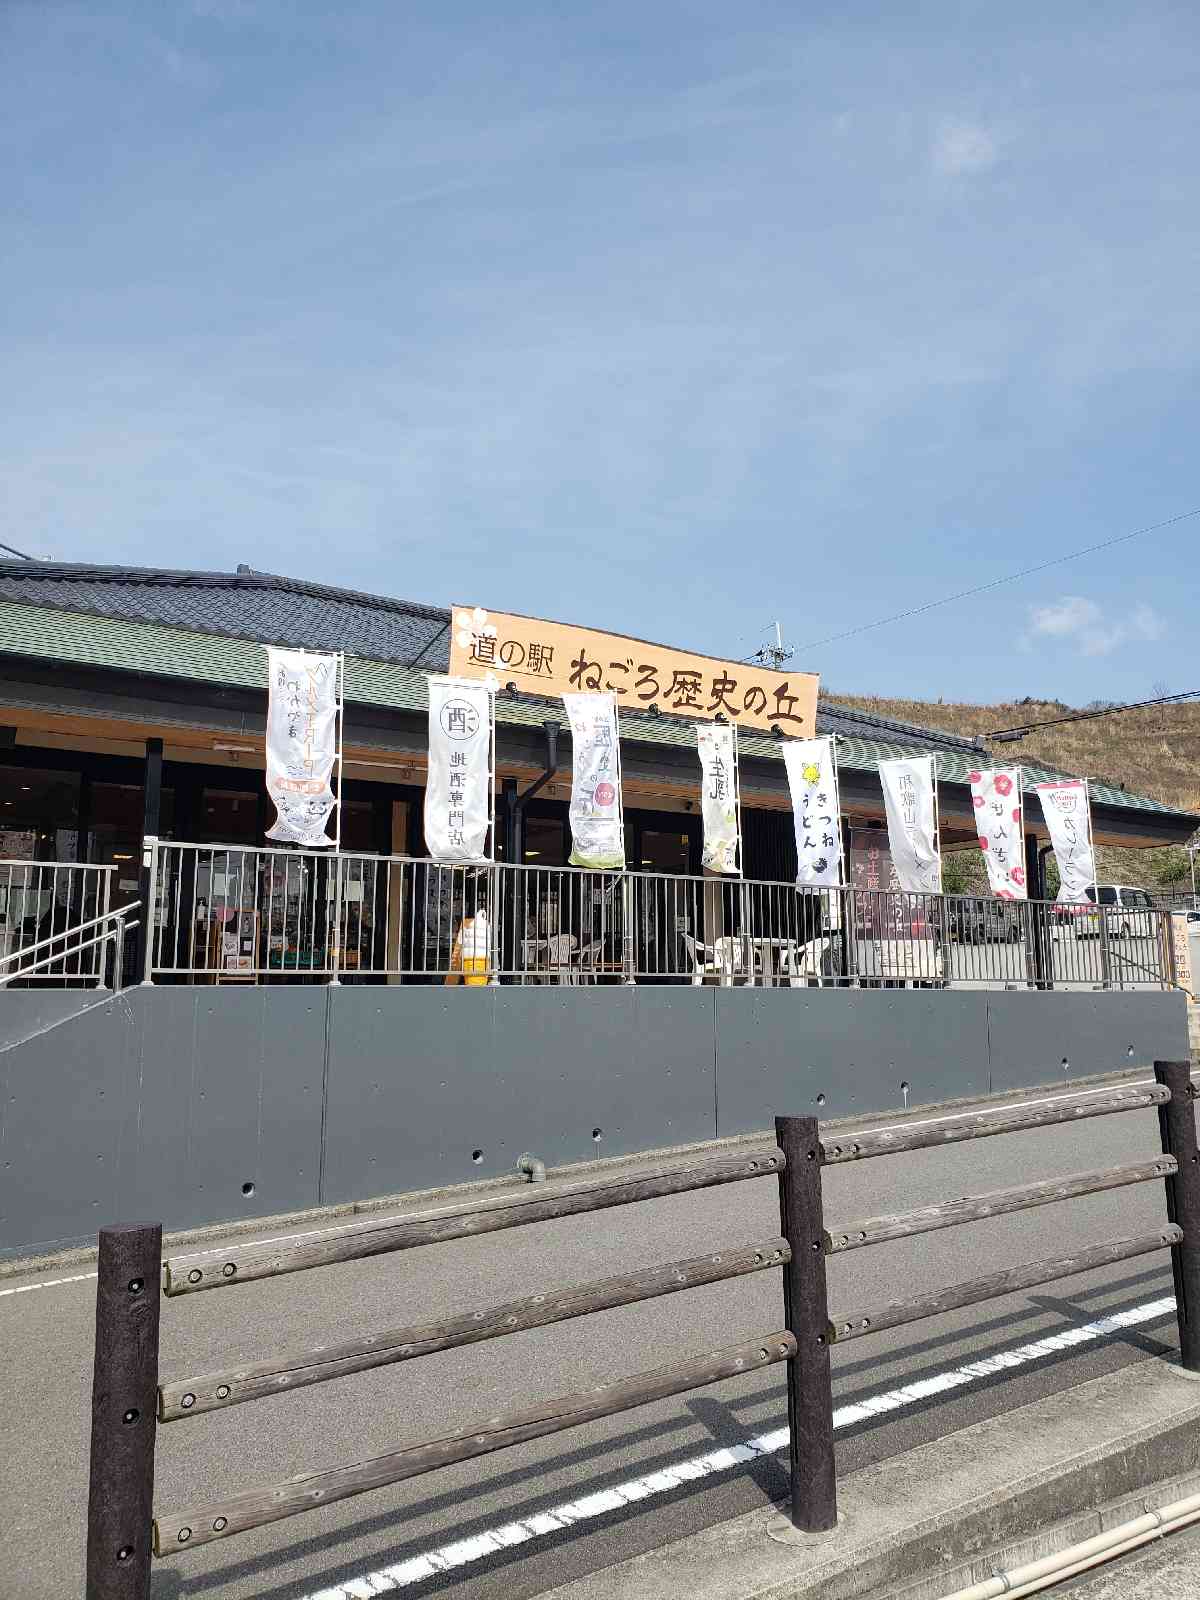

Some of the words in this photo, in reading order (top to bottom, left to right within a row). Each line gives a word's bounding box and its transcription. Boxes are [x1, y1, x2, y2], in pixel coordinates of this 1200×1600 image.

[468, 633, 555, 675] 道の駅
[569, 648, 804, 723] ねごろ歴史の丘
[802, 794, 817, 849] うどん
[816, 793, 834, 848] きつね
